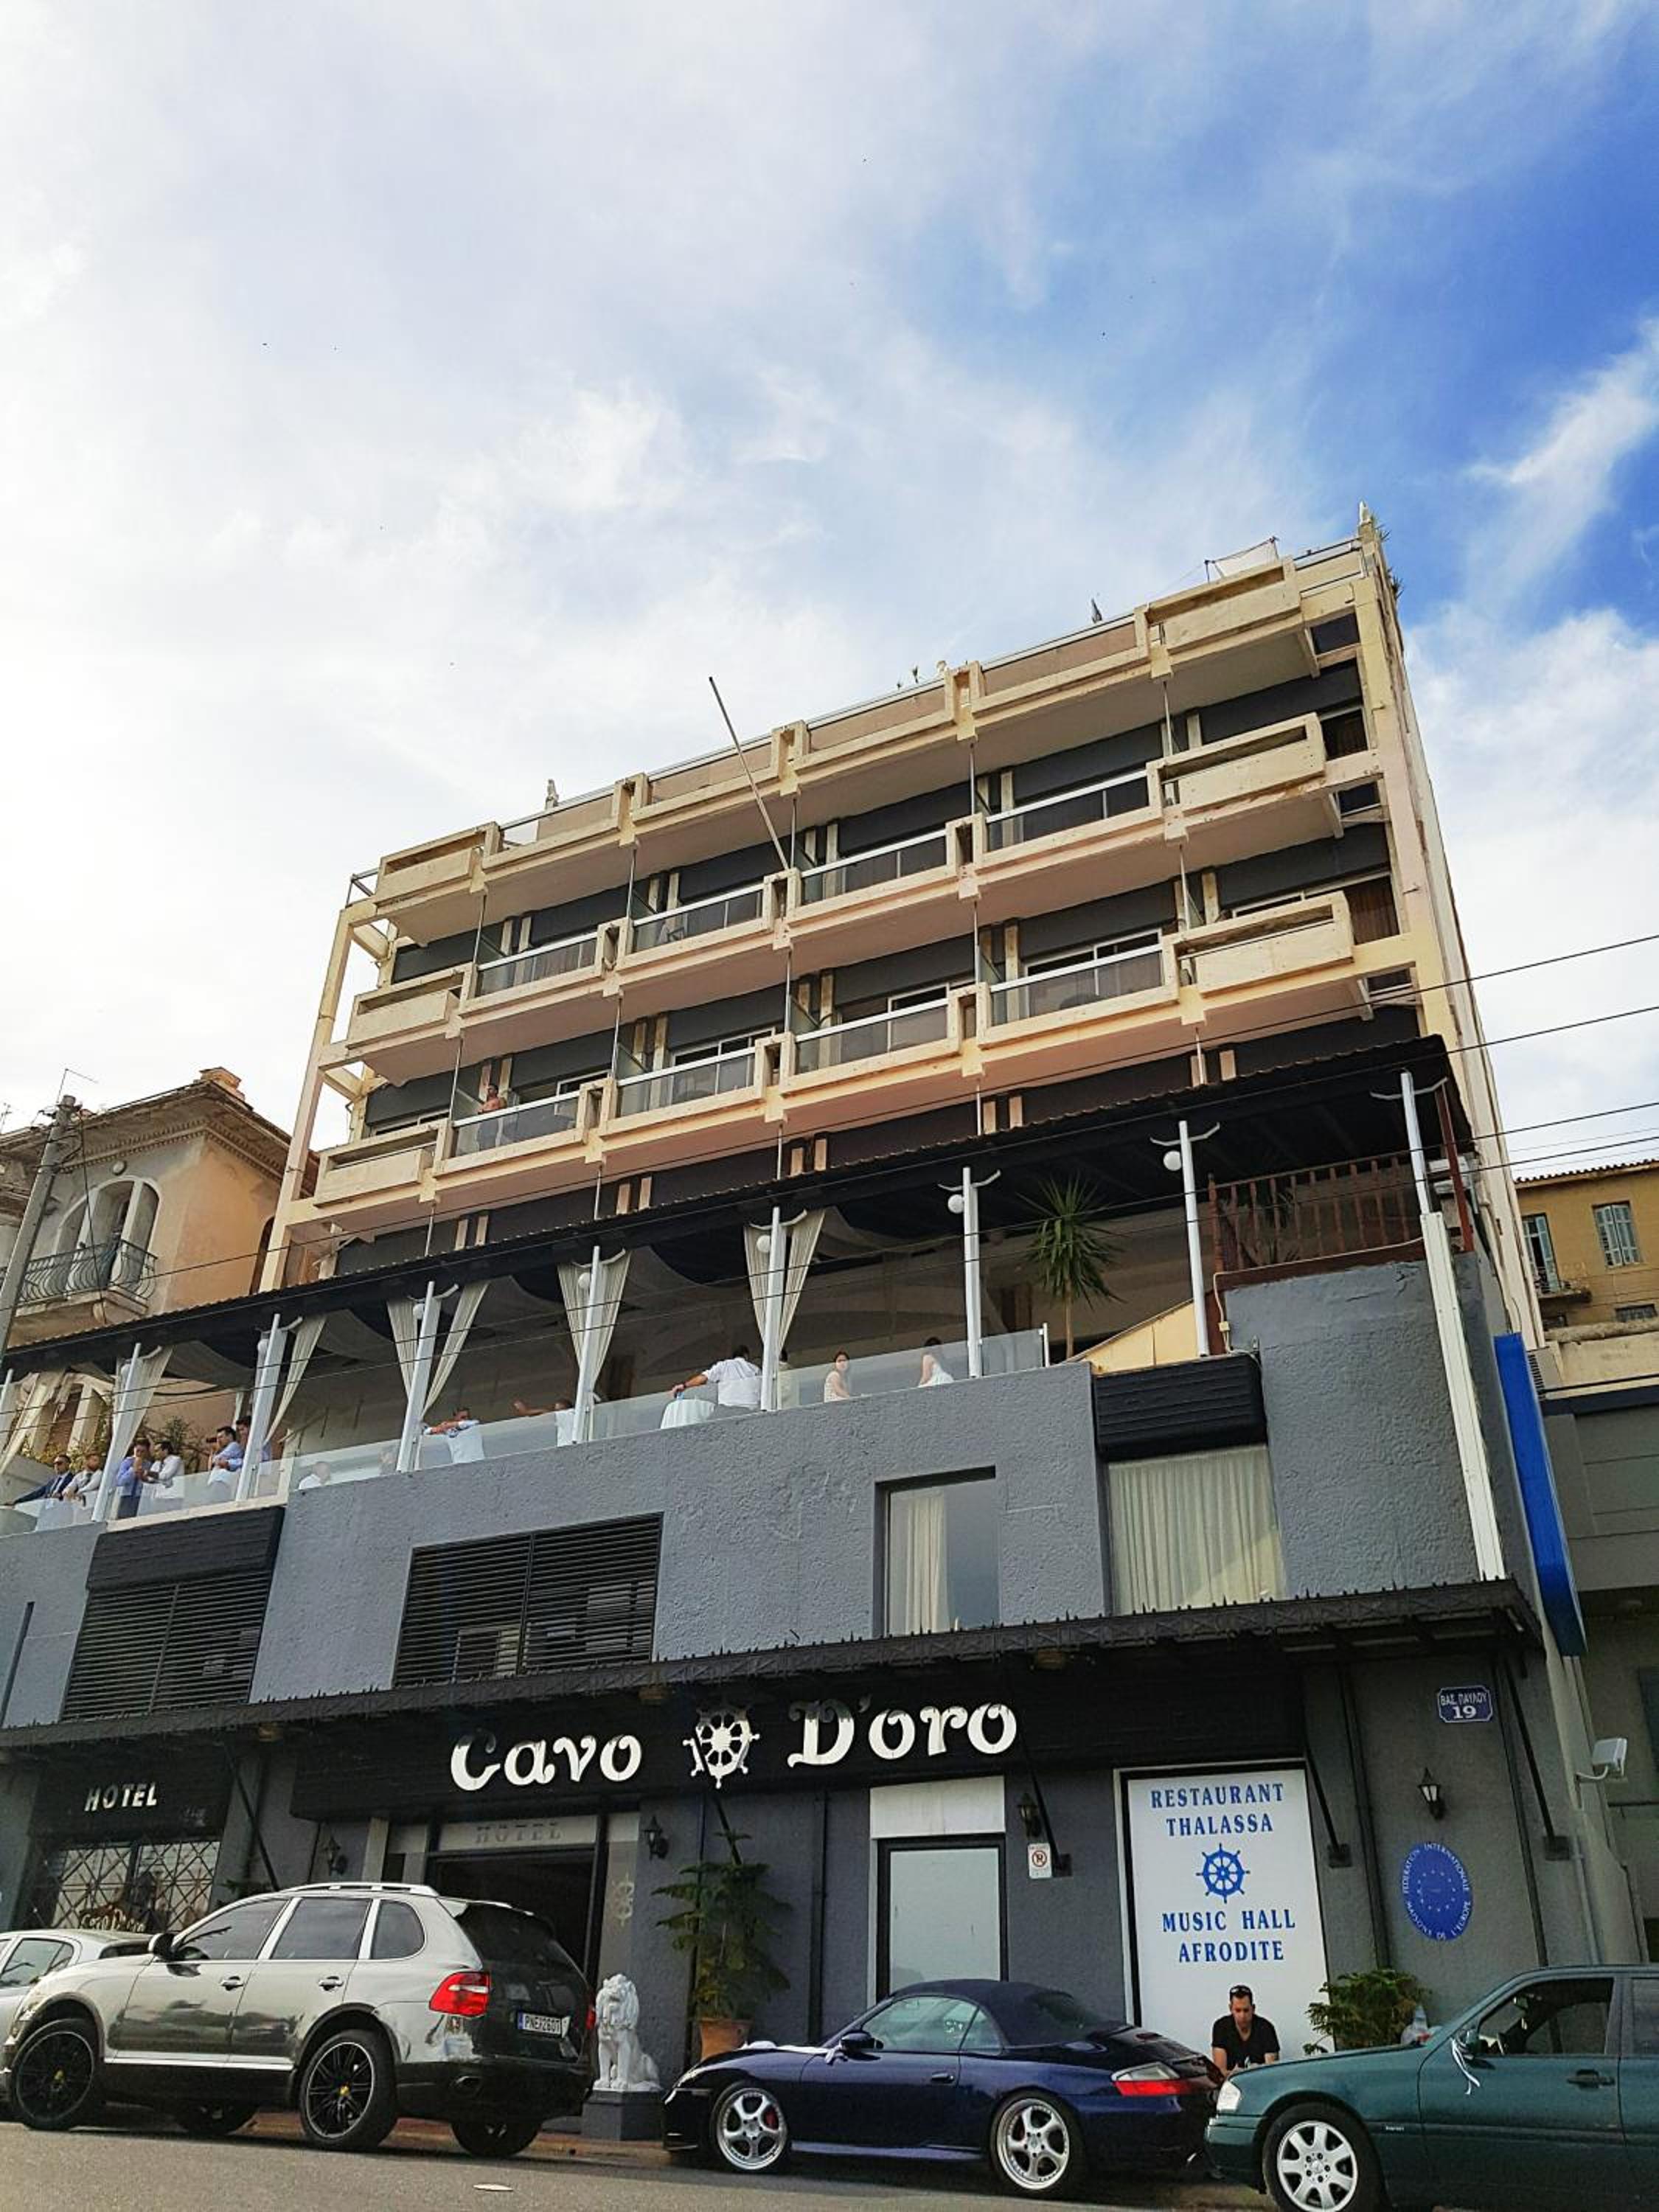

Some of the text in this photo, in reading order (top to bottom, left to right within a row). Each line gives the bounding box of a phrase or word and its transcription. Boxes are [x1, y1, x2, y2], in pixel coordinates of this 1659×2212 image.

[1452, 1705, 1477, 1719] 19
[450, 1694, 1018, 1791] Cavo D'oro
[83, 1781, 158, 1812] HOTEL
[1150, 1783, 1284, 1809] RESTAURANT
[1166, 1813, 1273, 1837] THALASSA
[1162, 1909, 1296, 1933] MUSIC HALL
[1178, 1940, 1284, 1964] AFRODITE
